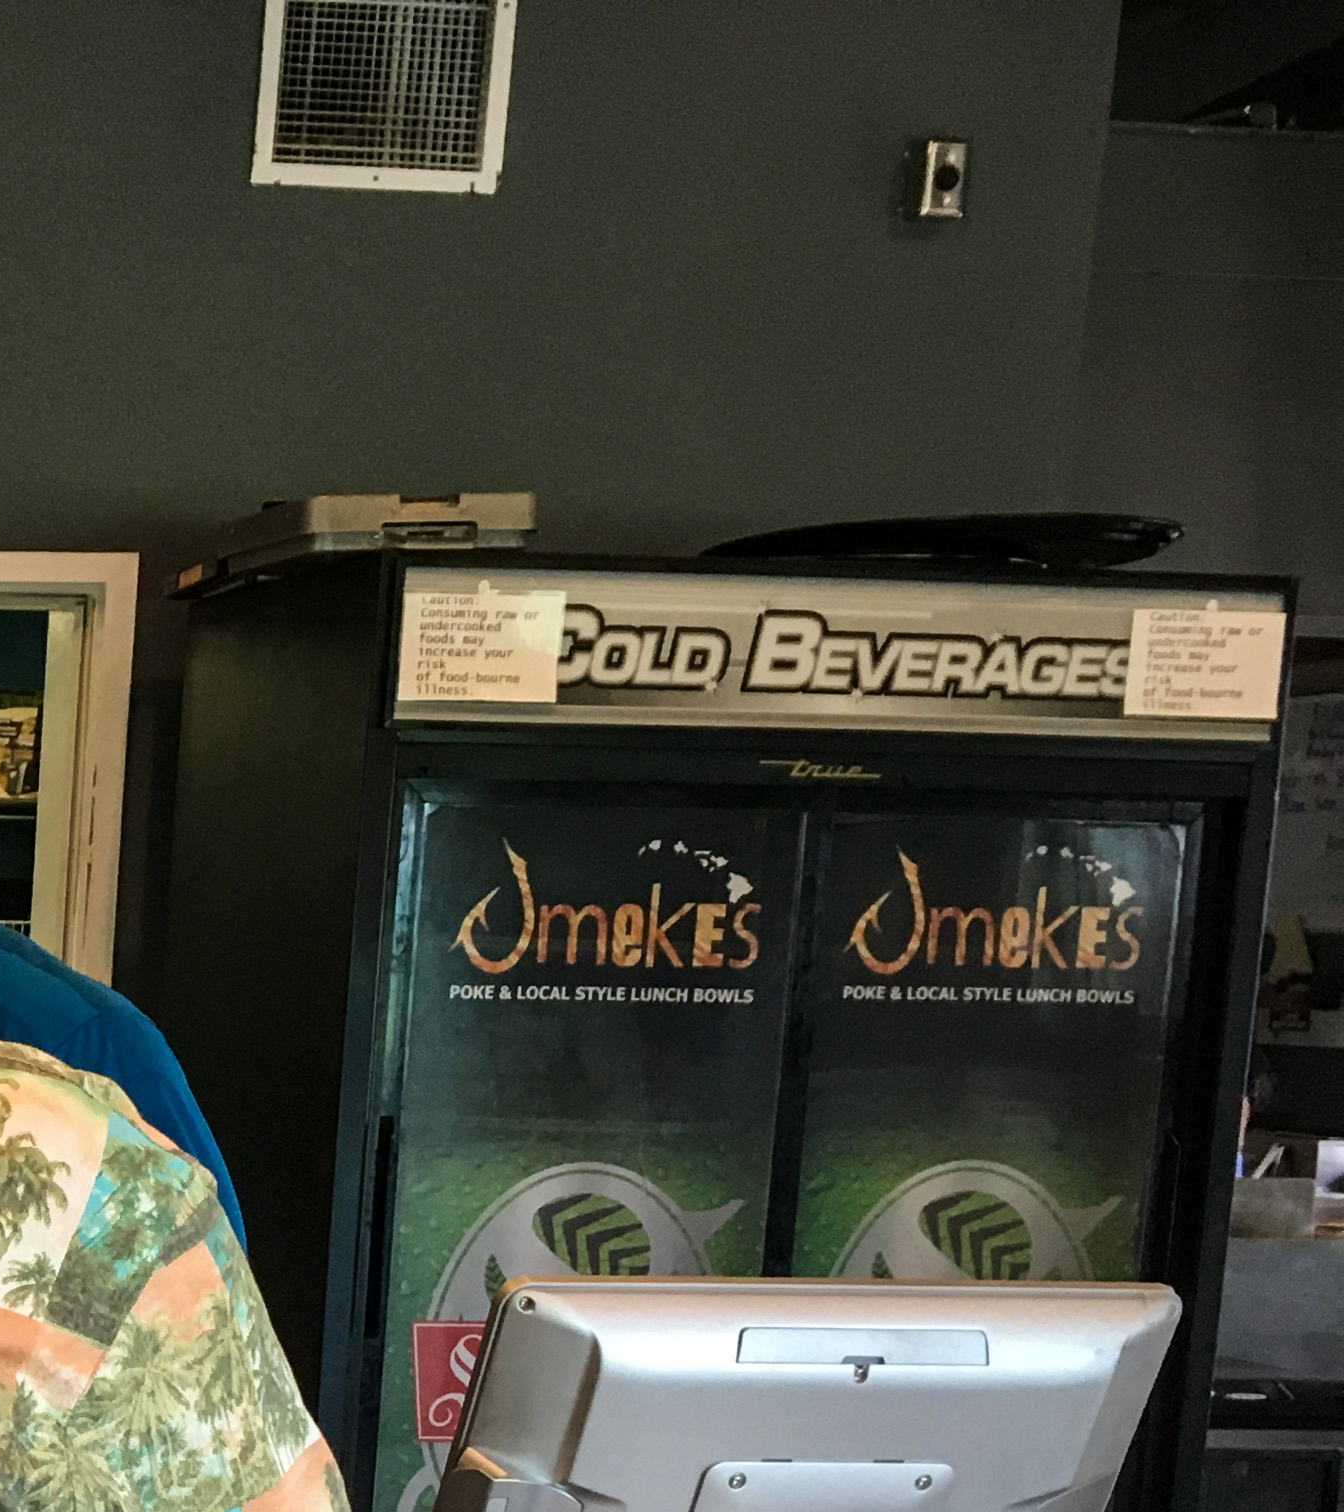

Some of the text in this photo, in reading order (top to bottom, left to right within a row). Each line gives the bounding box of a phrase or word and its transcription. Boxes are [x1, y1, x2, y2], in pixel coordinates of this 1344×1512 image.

[420, 607, 540, 621] Consuming raw or
[419, 620, 502, 632] undercooked
[1148, 624, 1213, 638] Consuming
[419, 633, 486, 647] foods may
[418, 646, 515, 660] increase your
[556, 604, 1129, 700] COLD BEVERAGES
[1147, 649, 1182, 661] foods
[417, 658, 447, 670] risk
[1209, 664, 1239, 676] your
[416, 671, 521, 684] of food-bourne
[449, 984, 754, 1004] POKE & LOCAL STYLE LUNCH BOWLS
[842, 985, 1135, 1005] POKE & LOCAL STYLE LUNCH BOWLS
